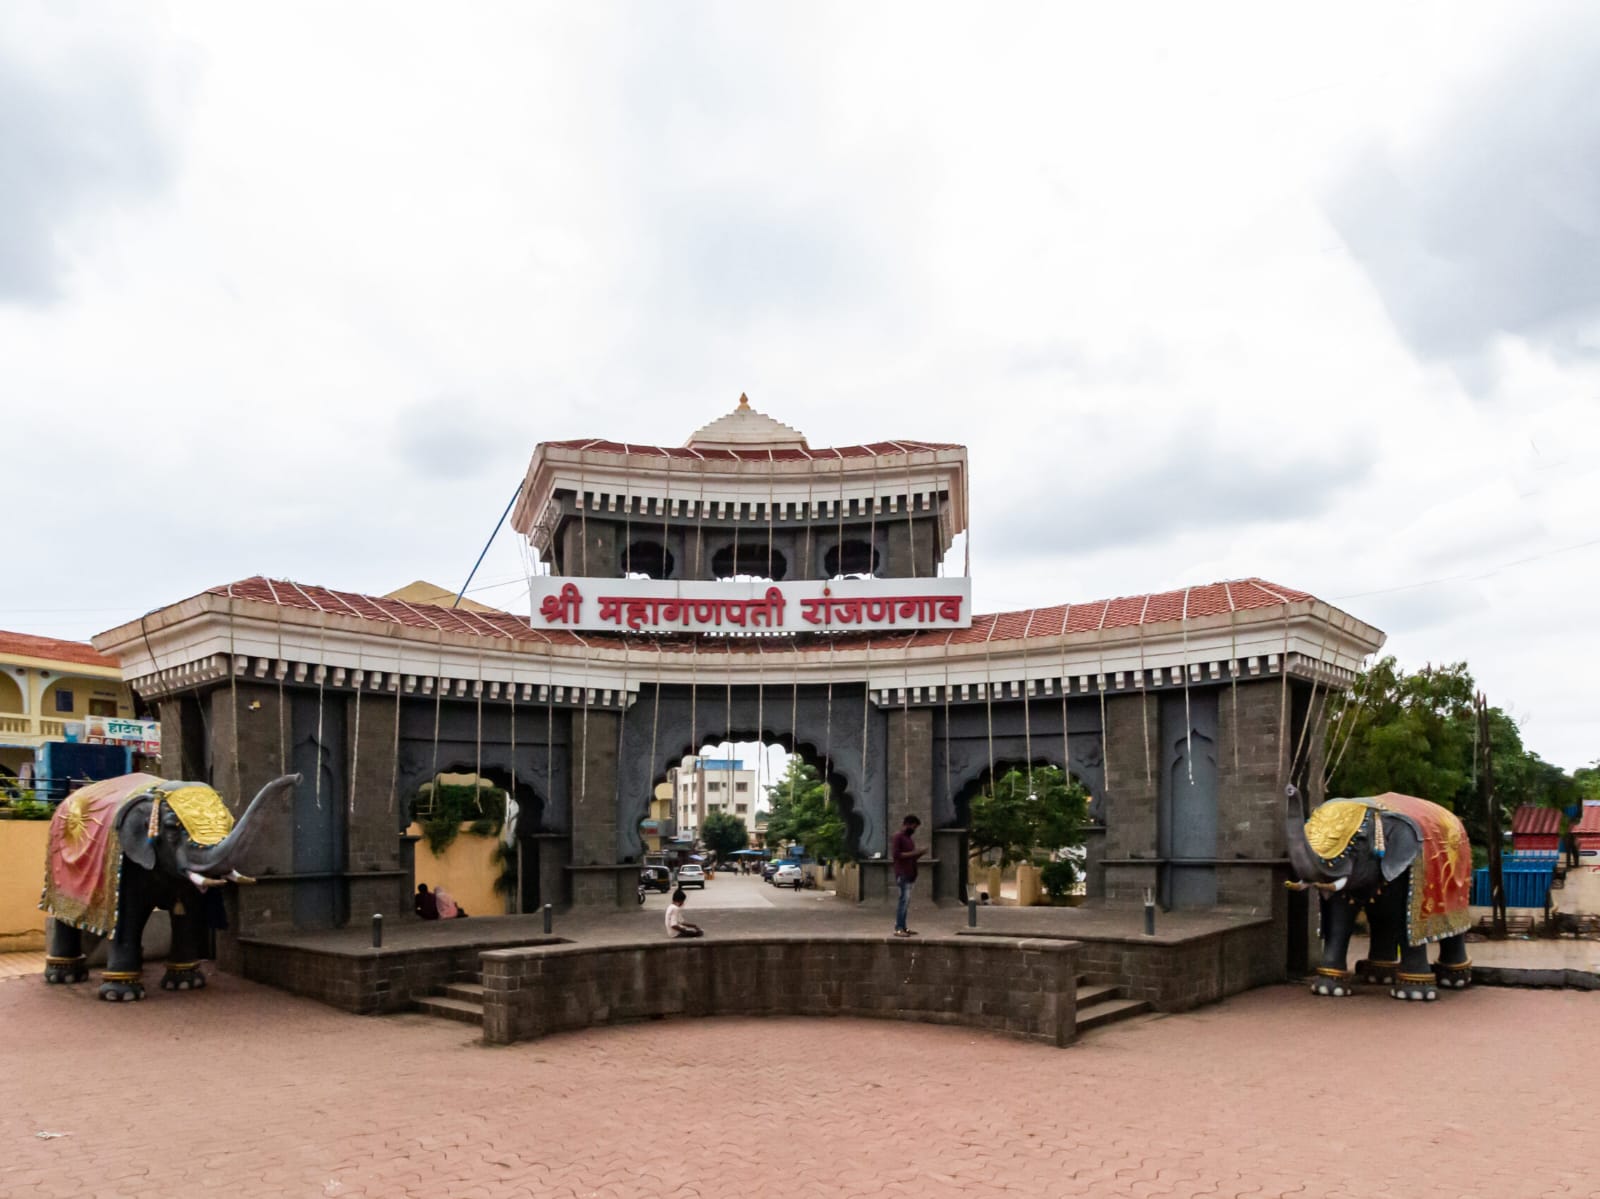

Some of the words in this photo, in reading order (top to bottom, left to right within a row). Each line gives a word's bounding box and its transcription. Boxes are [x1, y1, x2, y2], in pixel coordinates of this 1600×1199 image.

[540, 583, 583, 624] श्री
[598, 586, 786, 629] महागणपती
[800, 588, 963, 624] रांजणगाव
